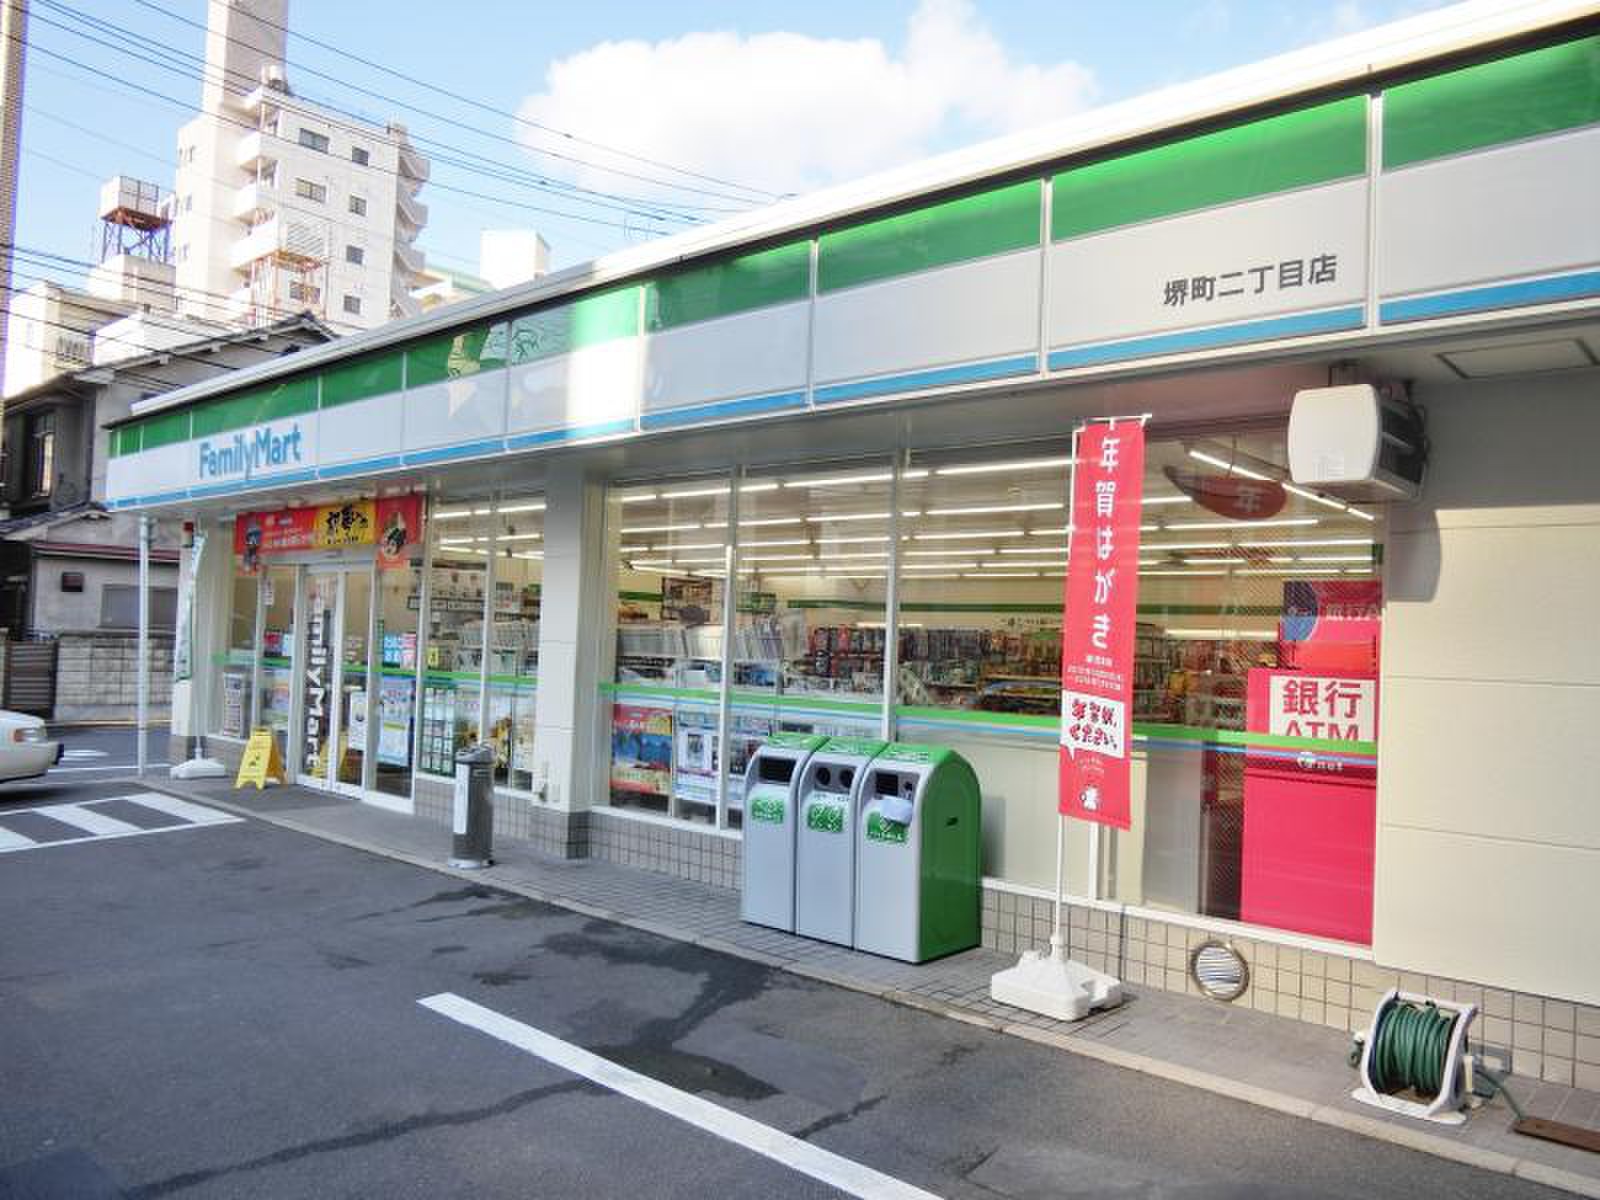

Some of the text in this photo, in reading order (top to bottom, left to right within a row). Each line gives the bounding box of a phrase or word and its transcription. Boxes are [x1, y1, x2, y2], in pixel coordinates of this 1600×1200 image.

[1164, 253, 1337, 307] 堺町二丁目店
[199, 423, 302, 480] FamilyMart
[1091, 436, 1121, 650] 年賀はがき
[1282, 679, 1363, 719] 銀行
